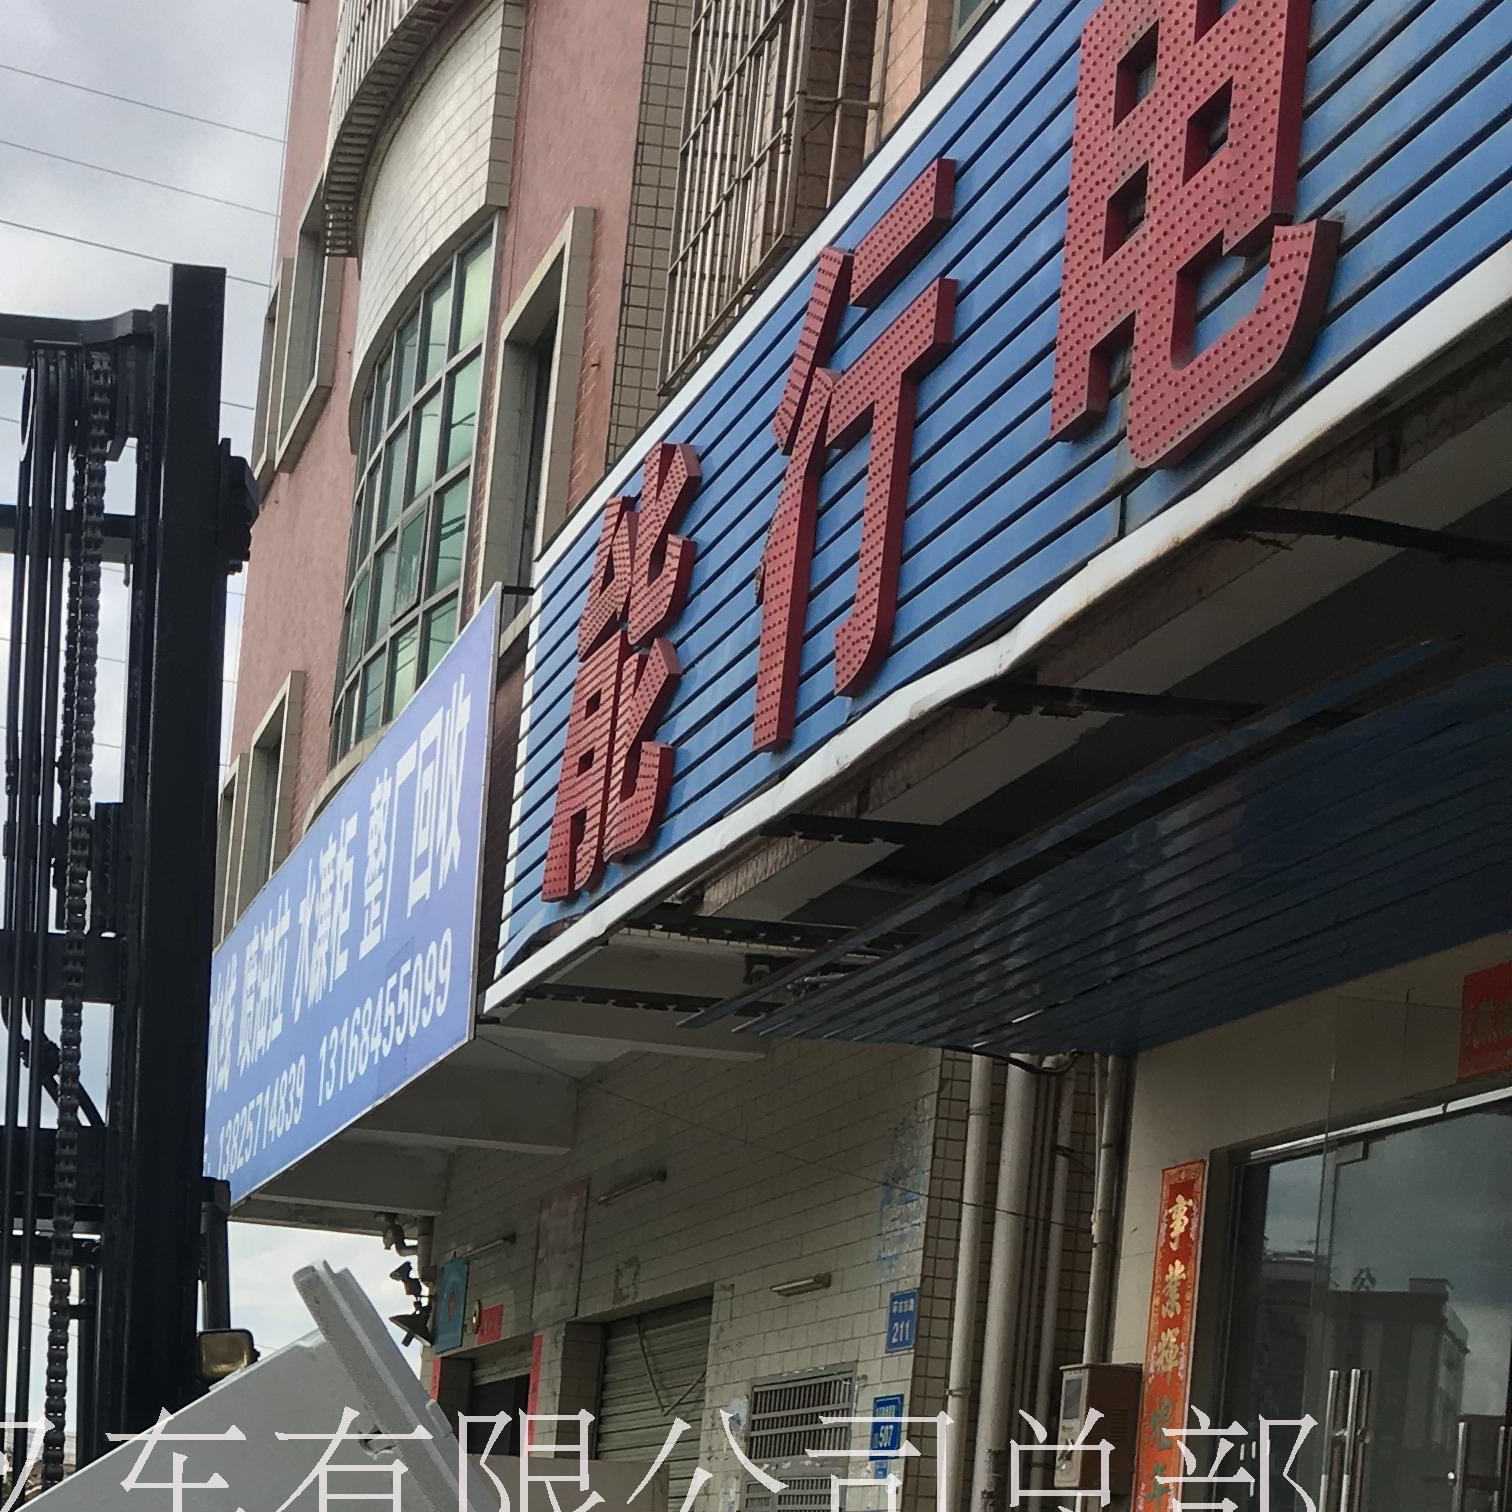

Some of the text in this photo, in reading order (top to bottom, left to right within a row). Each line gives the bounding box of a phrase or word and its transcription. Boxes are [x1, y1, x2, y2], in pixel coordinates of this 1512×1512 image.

[543, 0, 1345, 904] 能行电
[359, 673, 472, 962] 整厂回收
[218, 928, 453, 1180] 13825714839 13168455099
[891, 1320, 910, 1344] 211
